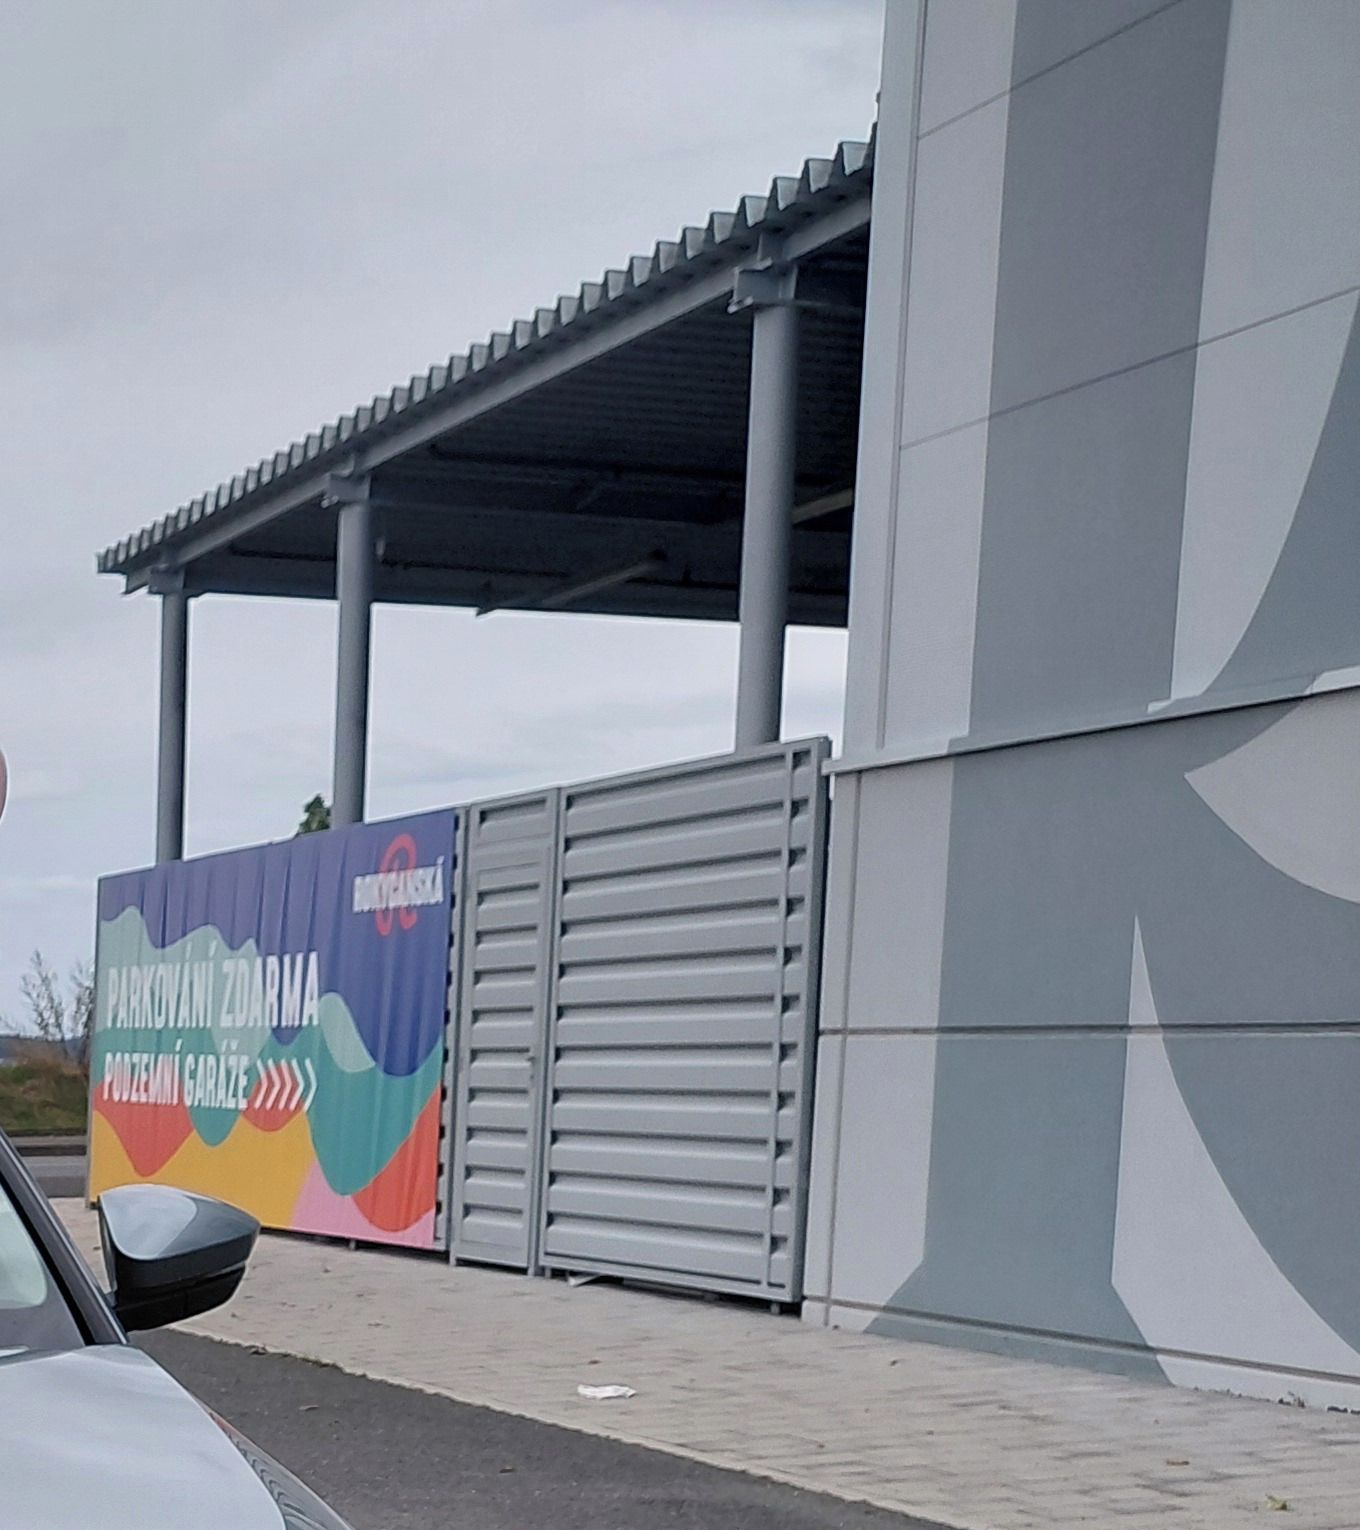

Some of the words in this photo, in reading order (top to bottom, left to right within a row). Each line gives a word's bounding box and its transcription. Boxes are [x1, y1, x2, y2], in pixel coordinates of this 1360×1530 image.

[107, 941, 217, 1029] PARKOVÁNÍ
[220, 951, 319, 1028] ZDARMA
[103, 1038, 182, 1106] PODZEMNÍ
[183, 1039, 250, 1110] GARÁŽE
